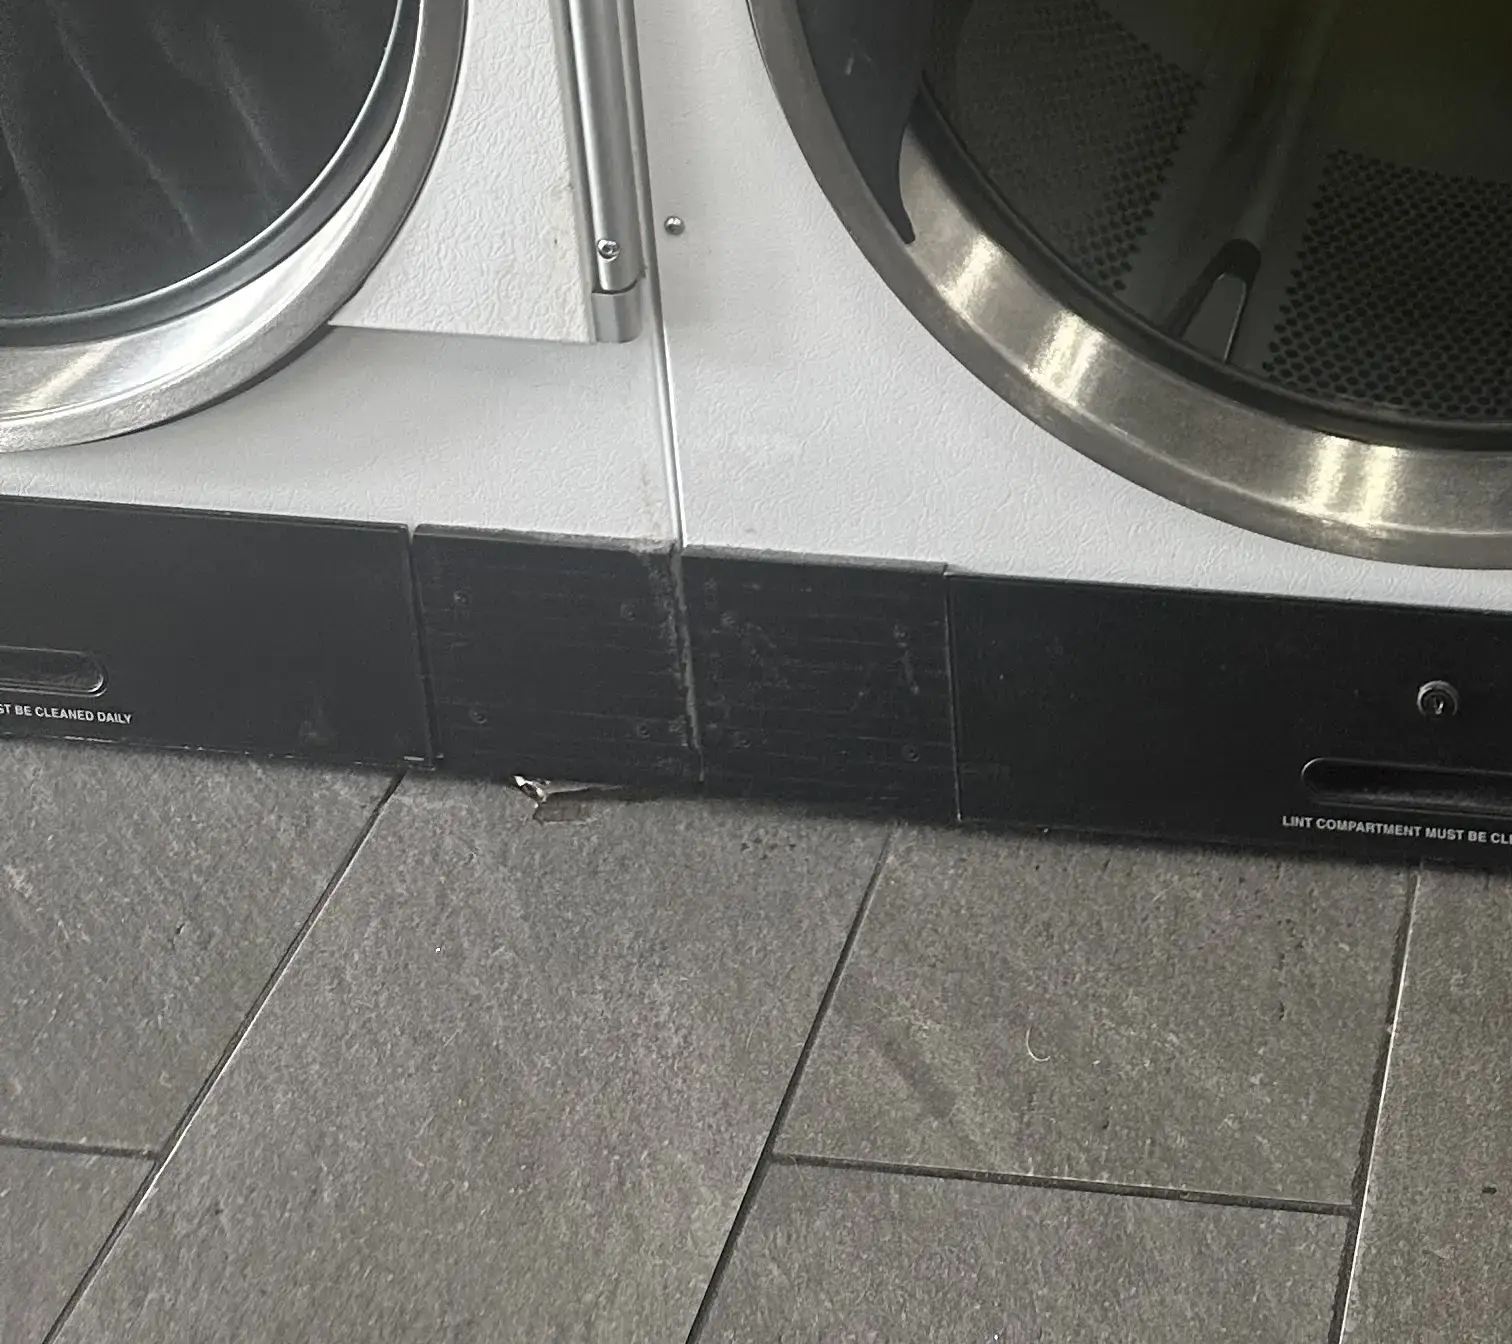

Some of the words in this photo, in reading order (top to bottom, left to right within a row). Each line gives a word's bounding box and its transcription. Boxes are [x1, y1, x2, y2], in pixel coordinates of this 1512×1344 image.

[14, 705, 33, 717] BE
[34, 706, 94, 721] CLEANED
[97, 712, 132, 724] DAILY
[1282, 815, 1314, 828] LINT
[1316, 817, 1422, 838] COMPARTMENT
[1425, 827, 1464, 842] MUST
[1468, 831, 1487, 843] BE
